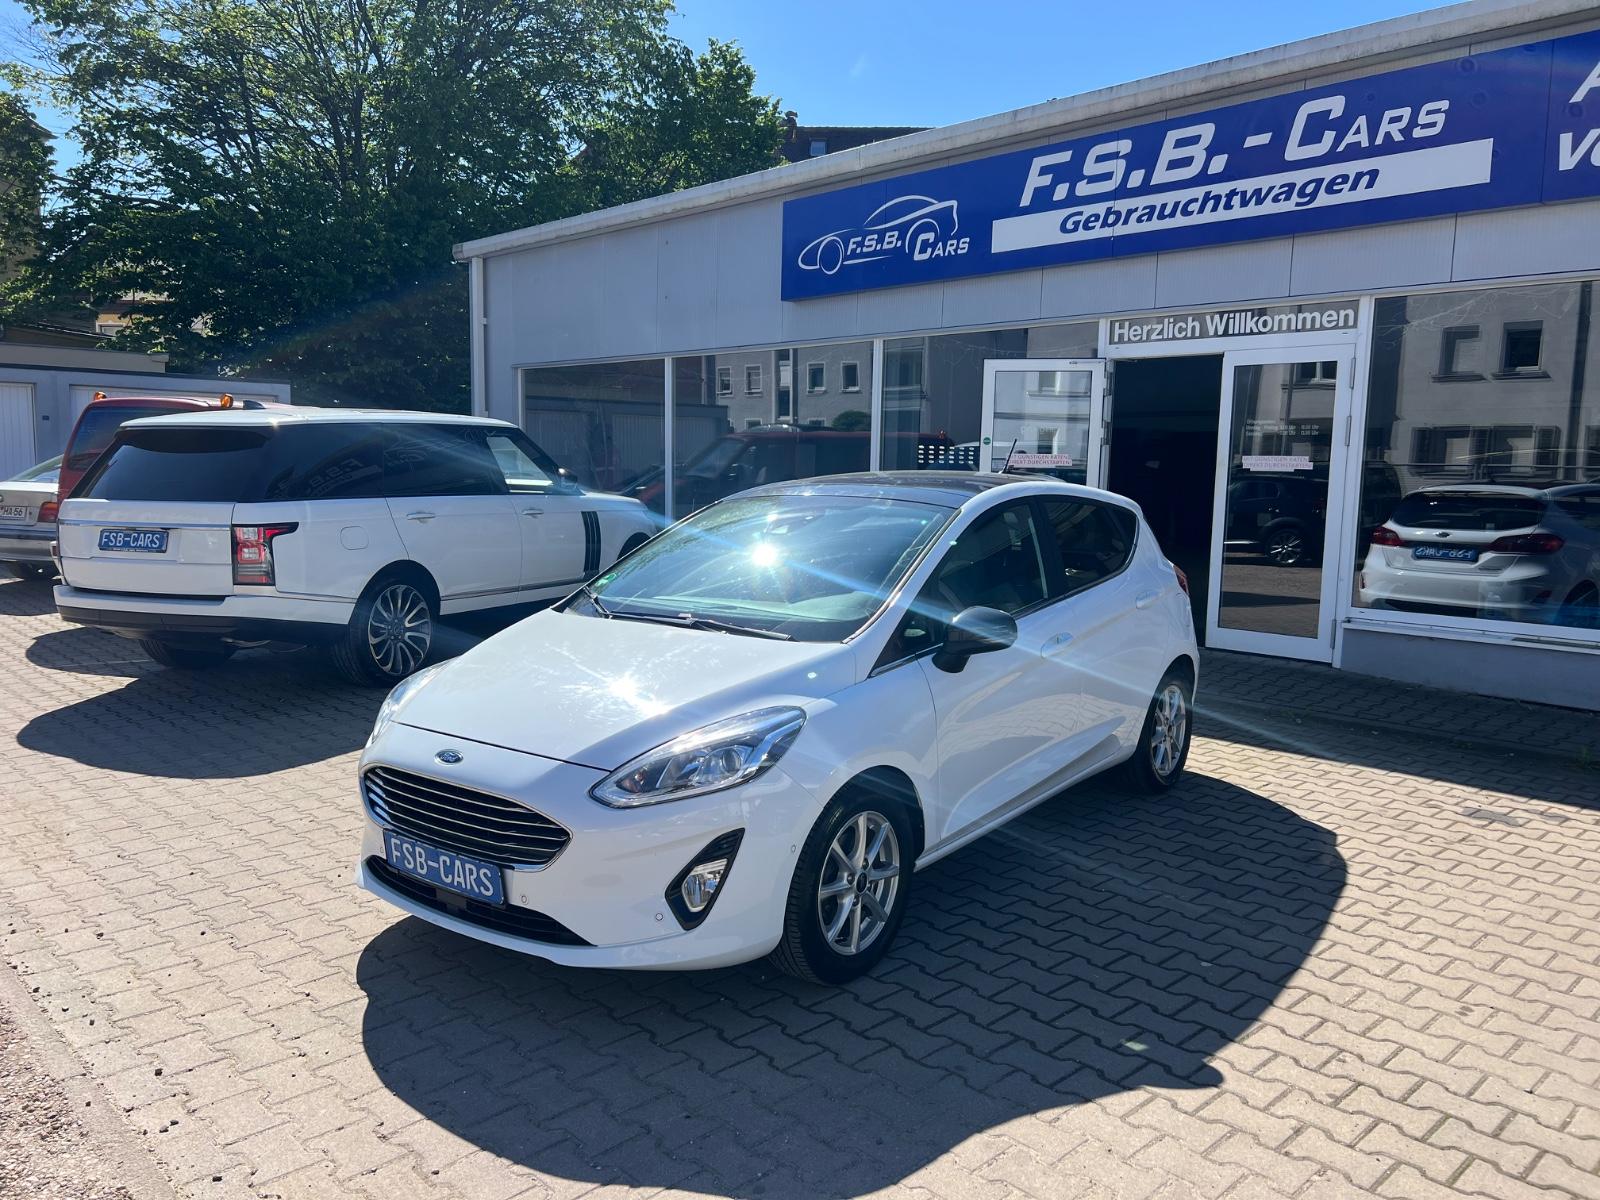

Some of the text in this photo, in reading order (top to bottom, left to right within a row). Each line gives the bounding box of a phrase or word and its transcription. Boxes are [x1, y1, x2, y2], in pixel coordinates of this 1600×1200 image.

[1059, 168, 1380, 234] Gebrauchtwagen
[847, 231, 902, 255] F.S.B.
[1113, 308, 1354, 342] Herzlich Willkommen
[101, 532, 160, 548] FSB-CARS
[390, 837, 494, 897] FSB-CARS
